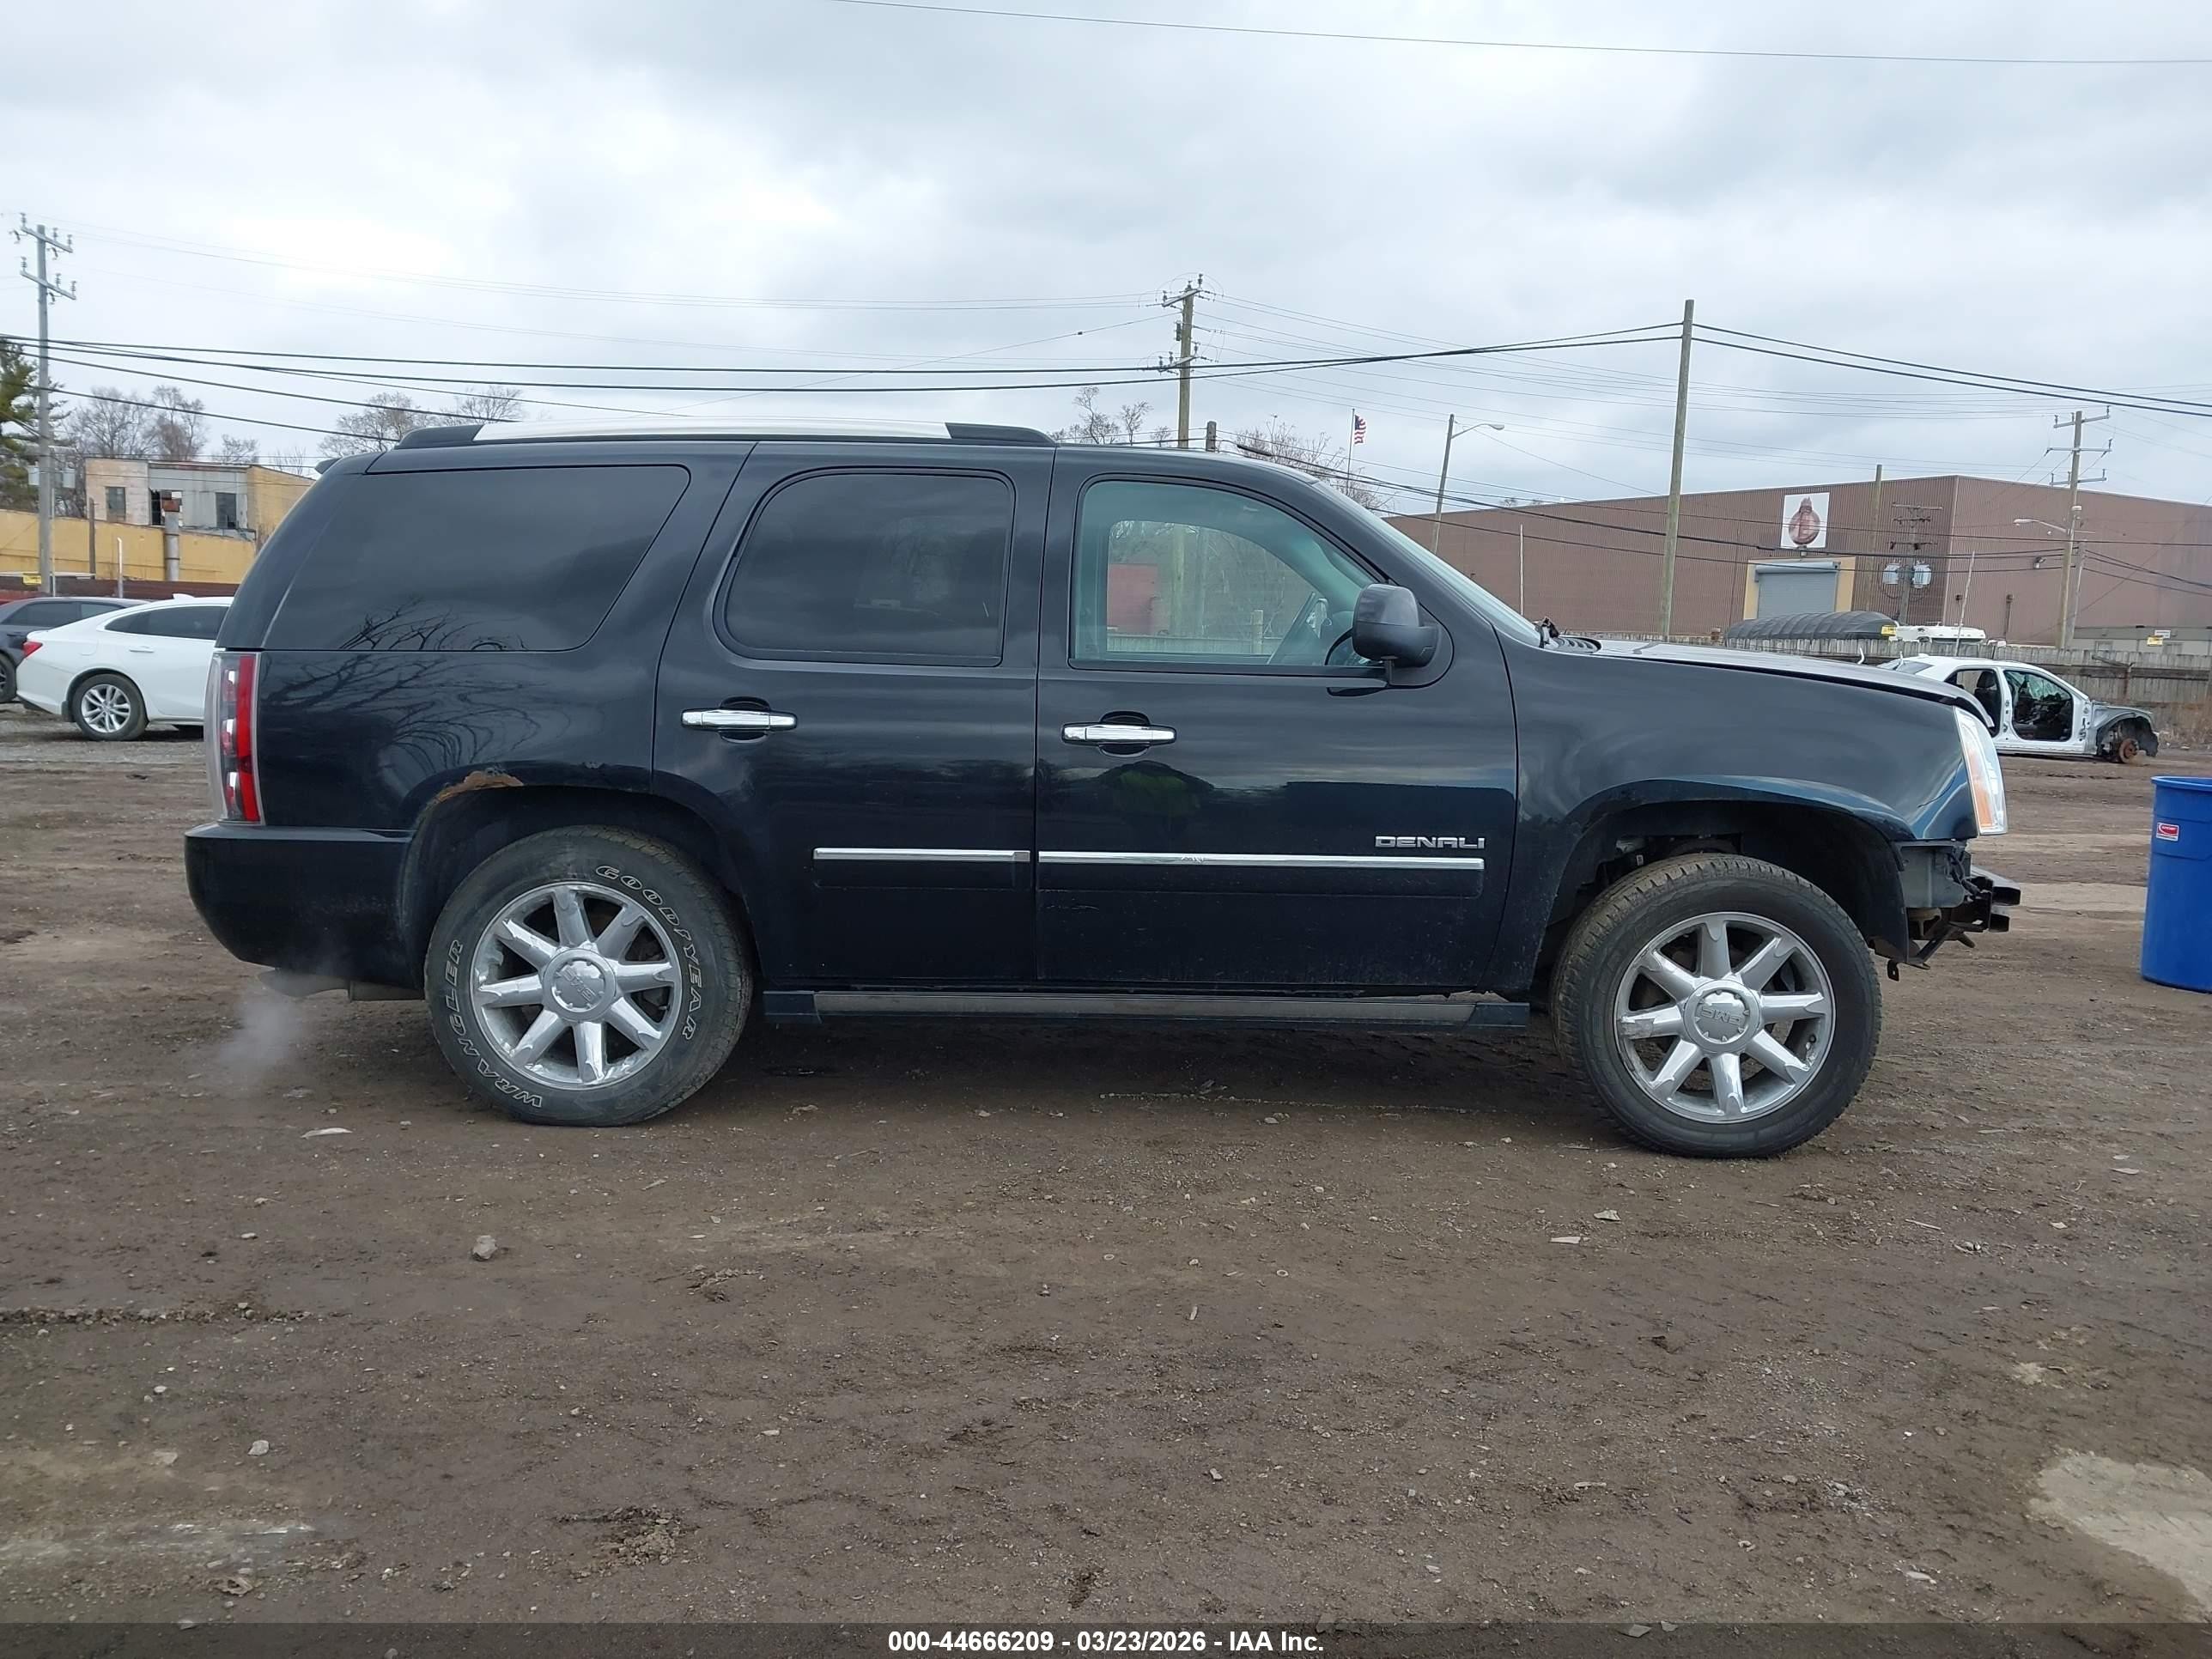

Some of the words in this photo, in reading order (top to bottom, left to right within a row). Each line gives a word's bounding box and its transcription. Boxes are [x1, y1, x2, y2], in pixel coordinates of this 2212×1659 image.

[1375, 836, 1485, 848] DENALI
[596, 866, 702, 1040] GOODYEAR
[445, 939, 543, 1109] WRANGLER
[1701, 1006, 1742, 1025] GMC
